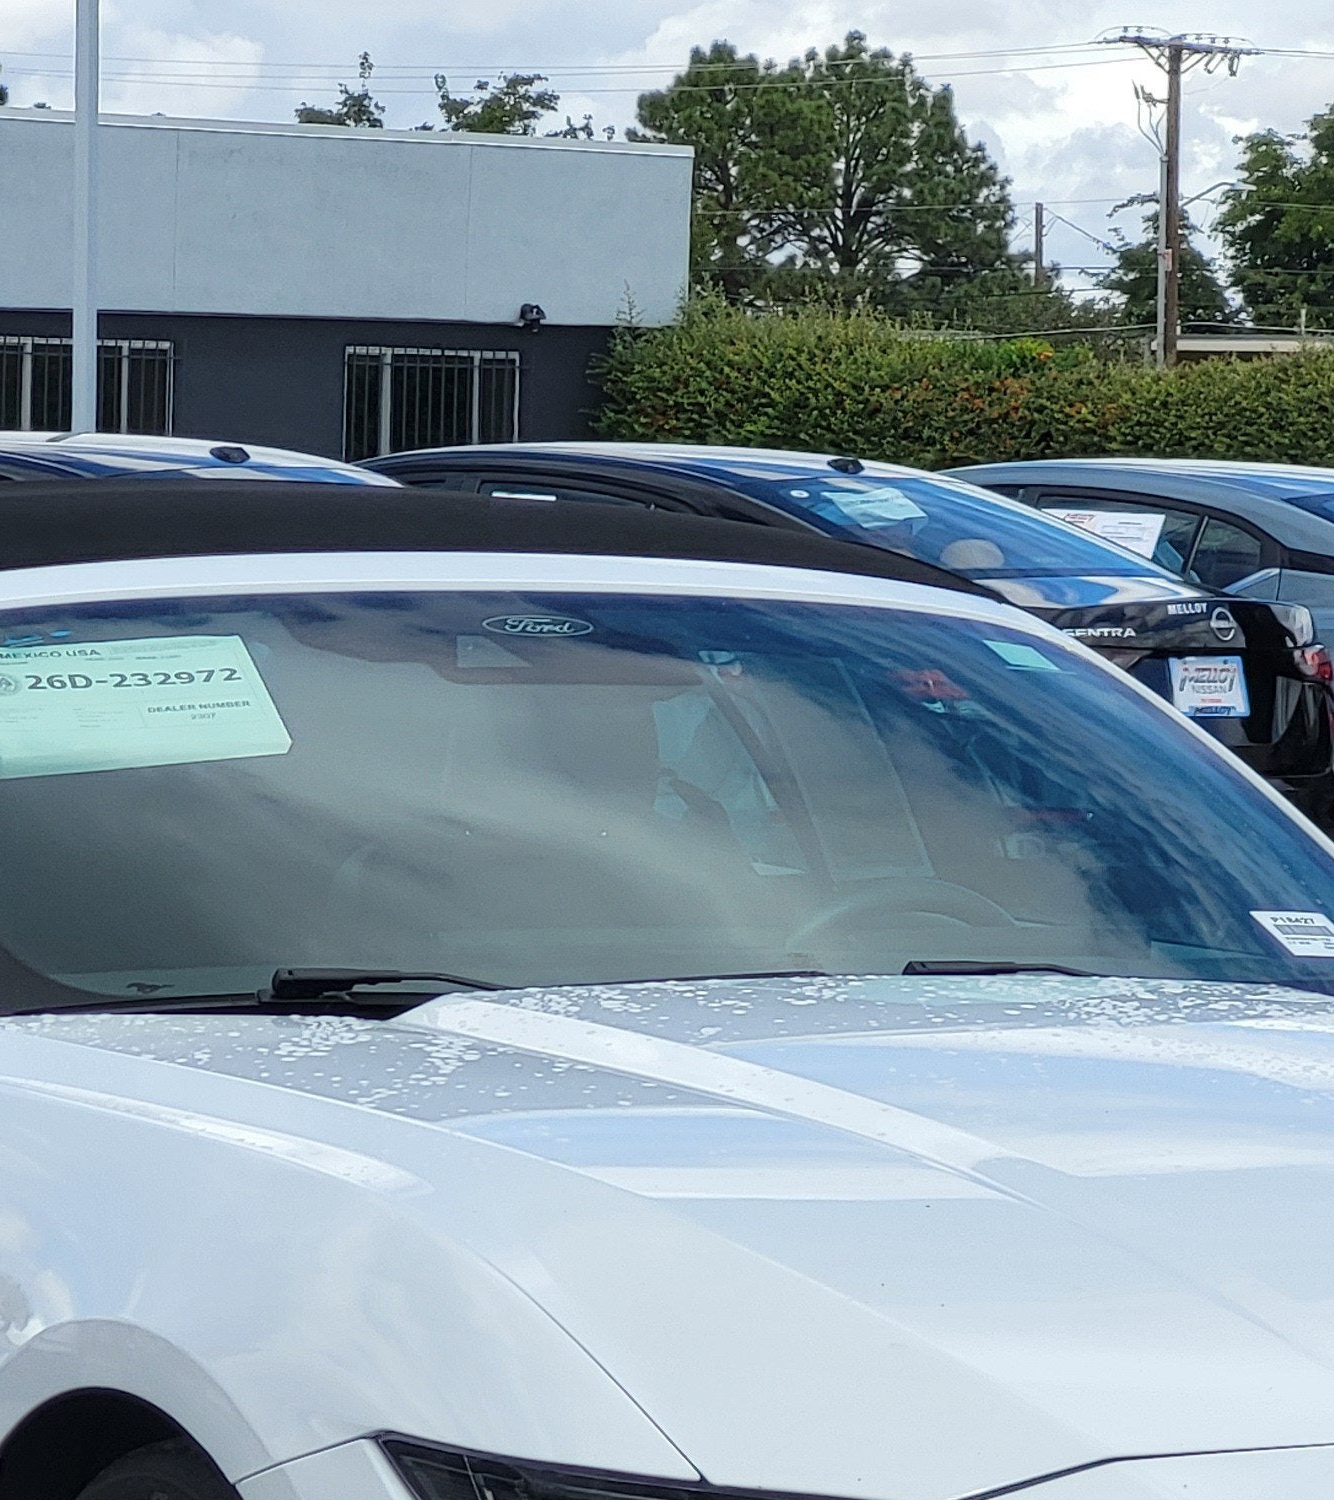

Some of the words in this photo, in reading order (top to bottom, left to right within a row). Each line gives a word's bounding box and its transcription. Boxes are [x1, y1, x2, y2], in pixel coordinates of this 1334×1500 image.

[1167, 602, 1208, 615] MELLOY
[504, 618, 575, 633] Ford
[65, 649, 102, 658] USA
[24, 667, 242, 690] 26D-232972
[147, 703, 197, 713] DEALER
[198, 700, 251, 710] NUMBER
